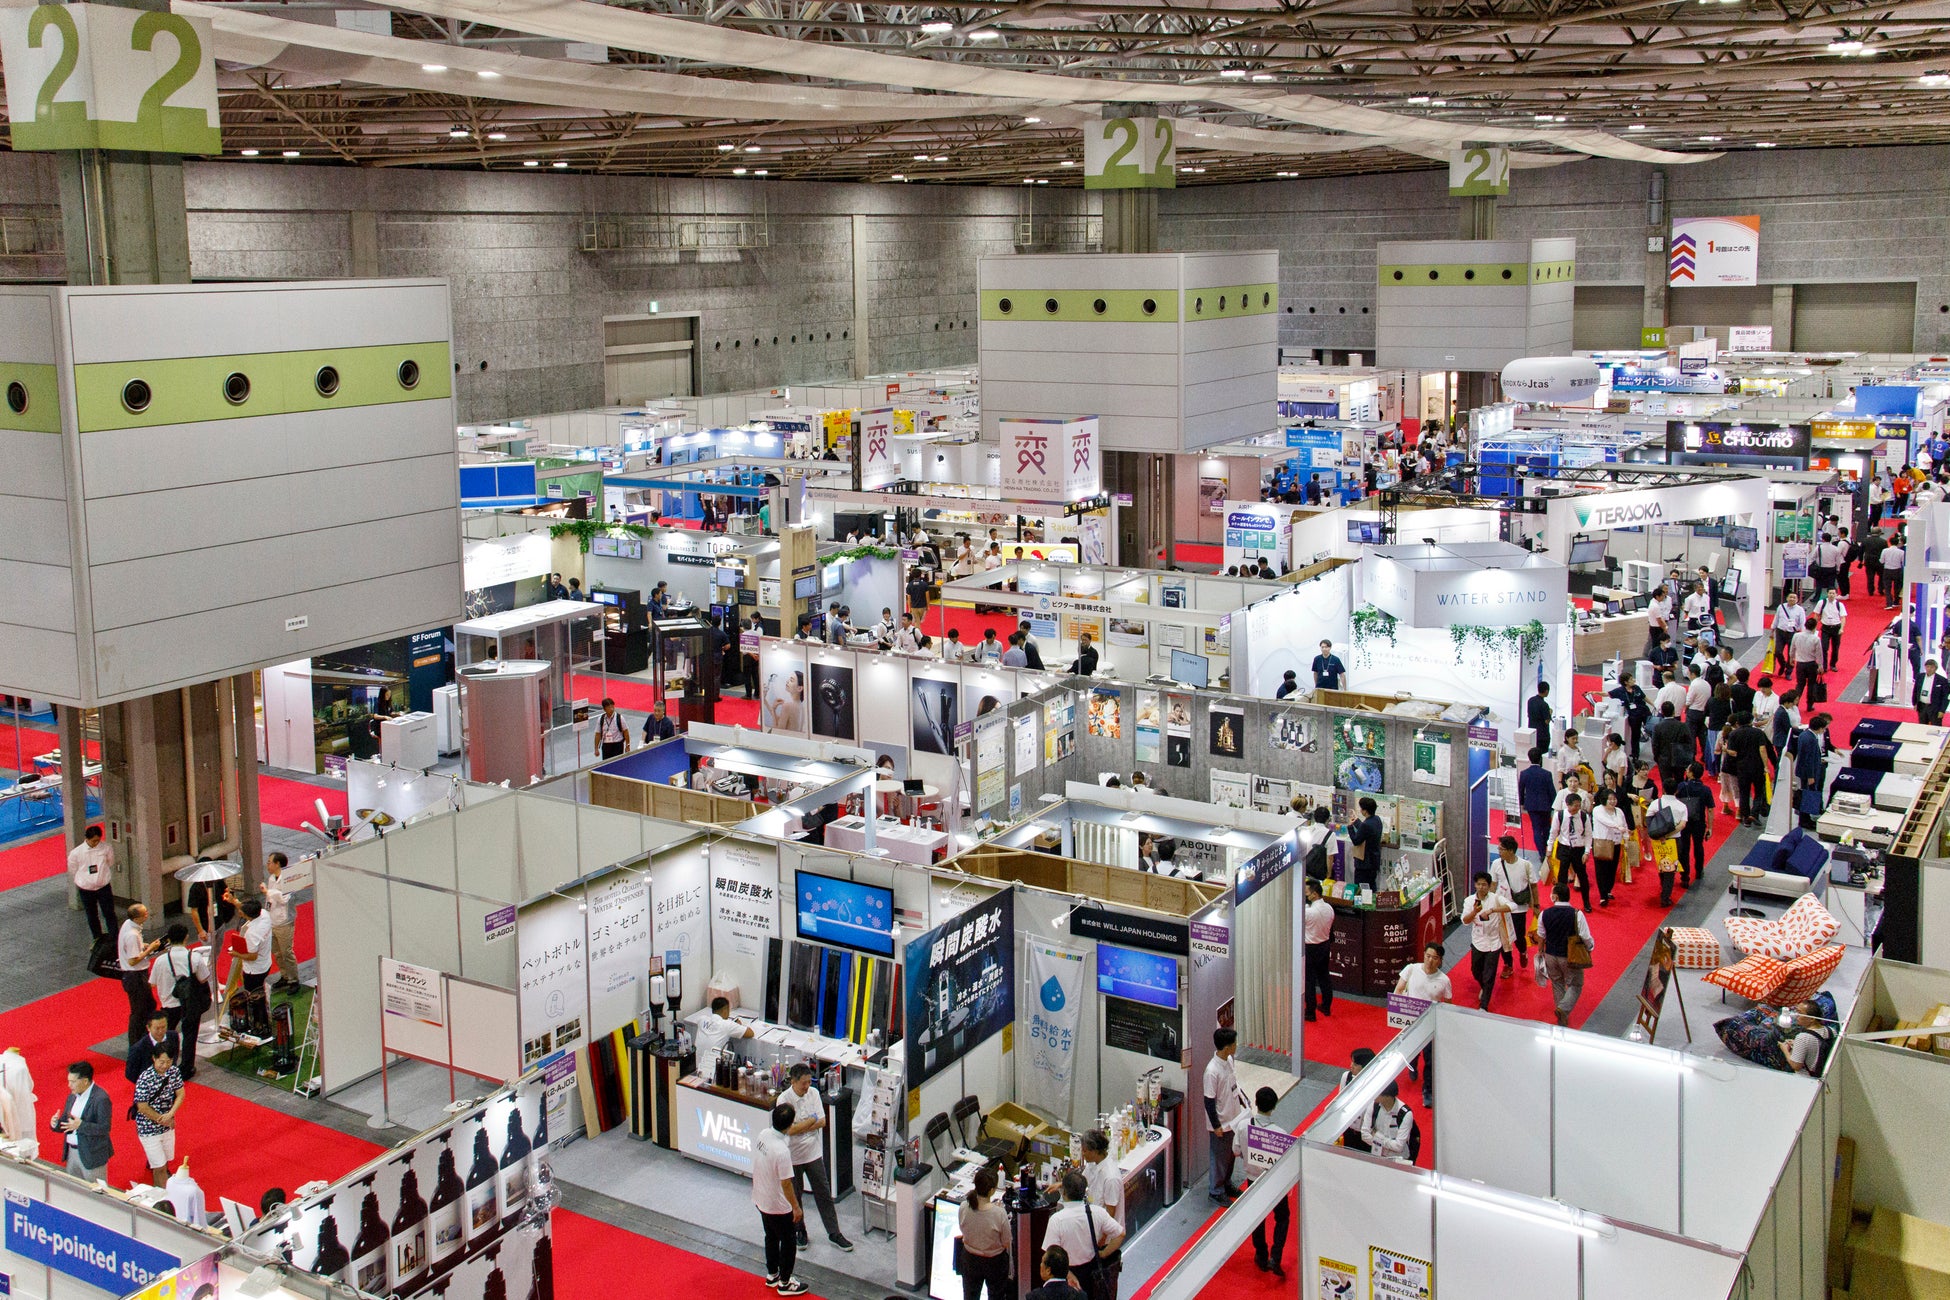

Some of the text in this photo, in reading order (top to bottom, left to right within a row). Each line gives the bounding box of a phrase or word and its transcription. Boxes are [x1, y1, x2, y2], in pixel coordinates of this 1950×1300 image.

[27, 11, 89, 123] 2
[131, 13, 209, 128] 2
[1103, 118, 1141, 176] 2
[1154, 119, 1174, 175] 2
[1463, 149, 1492, 187] 2
[1500, 149, 1509, 186] 2
[1634, 376, 1720, 388] サイトコントローラー
[1722, 435, 1793, 449] CHUUMO
[1595, 501, 1663, 526] TERAOKA
[1051, 600, 1112, 615] ビクター商事株式会社
[1437, 590, 1547, 606] WATER STAND
[411, 631, 441, 643] SF Forum
[1180, 840, 1218, 852] ABOUT
[656, 886, 701, 915] を目指して
[714, 877, 773, 900] 瞬間炭酸水
[929, 906, 1003, 969] 瞬間炭酸水
[1081, 918, 1178, 942] 株式会社 WILL JAPAN HOLDINGS
[1383, 929, 1409, 937] ABOUT
[522, 938, 582, 970] ペットボトル
[1192, 942, 1228, 955] K2-AG03
[523, 959, 582, 991] サステナブルな
[1032, 1014, 1072, 1038] 無料給水
[1389, 1015, 1415, 1027] K2-A
[1250, 1153, 1277, 1167] K2-A
[6, 1190, 29, 1207] チーム名
[13, 1212, 117, 1274] Five-pointed
[1381, 1272, 1419, 1290] 非常時に役立つ
